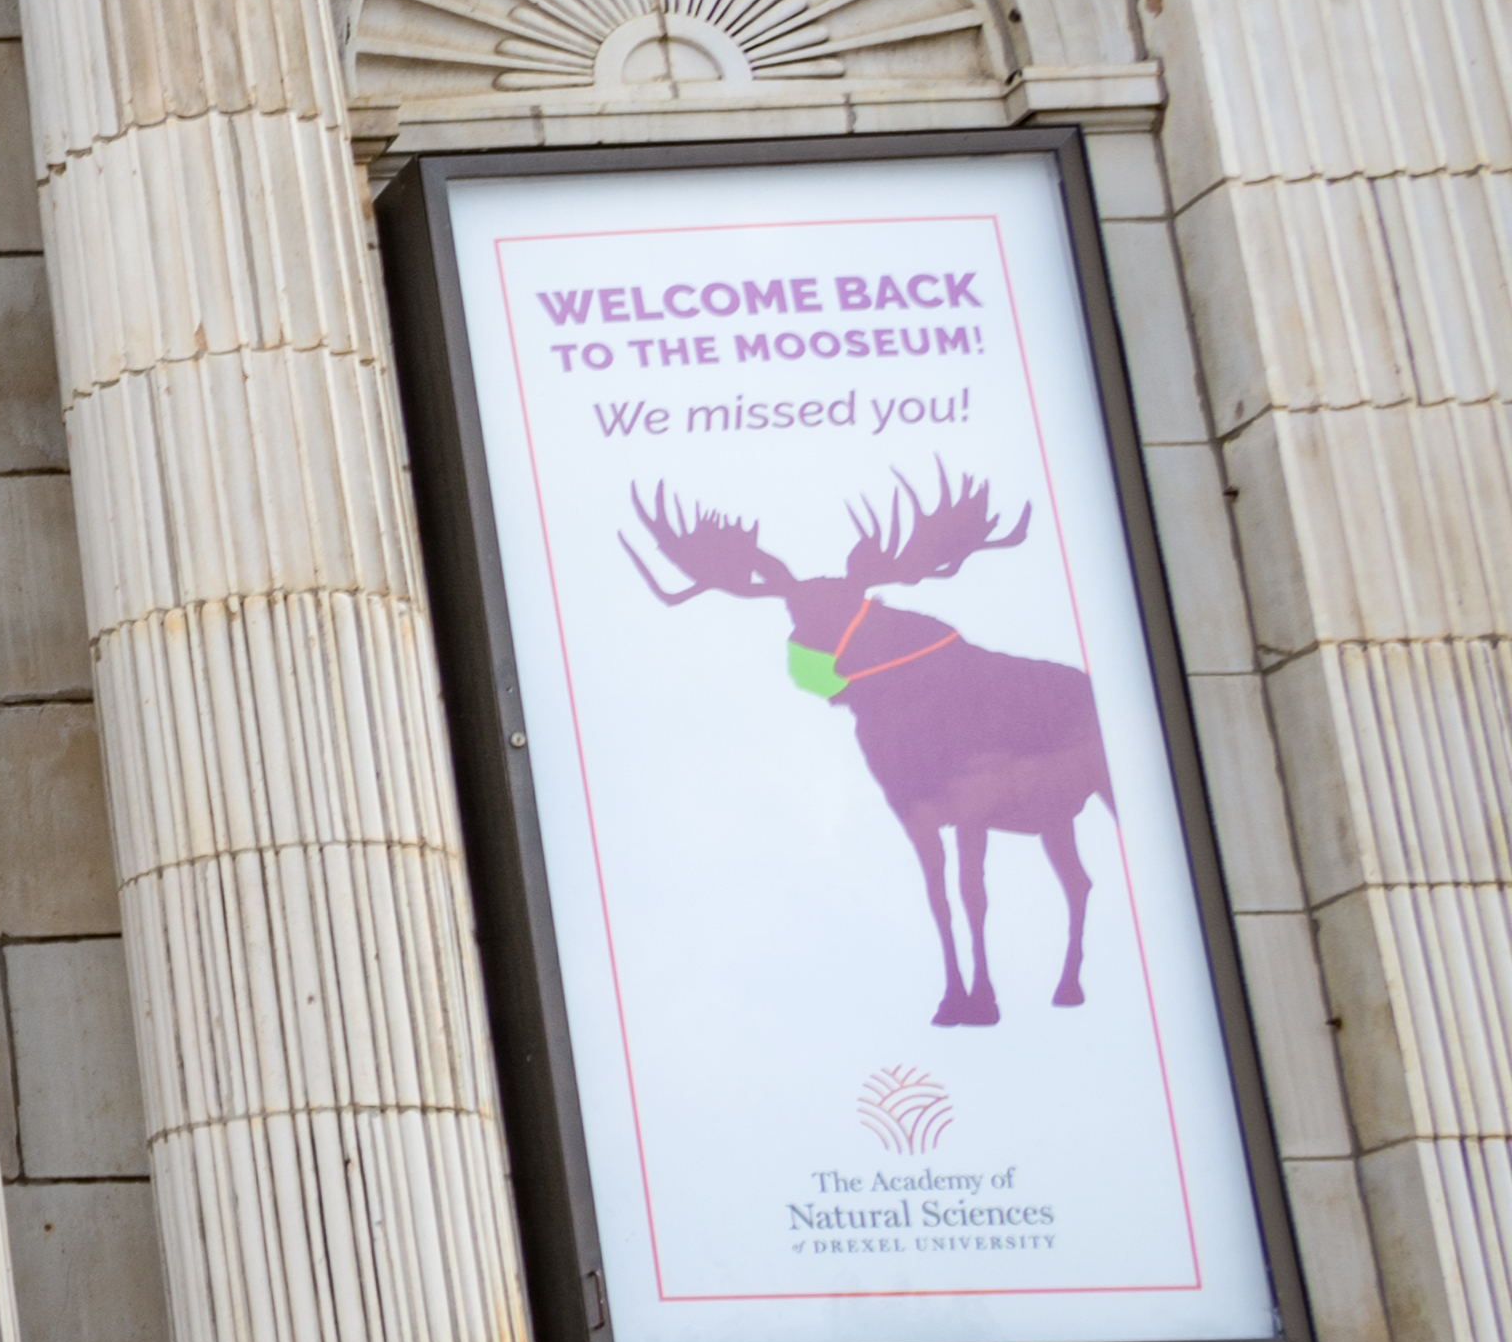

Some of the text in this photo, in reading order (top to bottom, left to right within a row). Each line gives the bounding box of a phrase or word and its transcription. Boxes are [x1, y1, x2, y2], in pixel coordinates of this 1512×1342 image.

[535, 272, 984, 326] WELCOME BACK
[550, 325, 985, 373] TO THE MOOSEUM!
[593, 387, 970, 438] We missed you!
[812, 1166, 1017, 1195] The Academy of
[786, 1198, 1056, 1230] Natural Sciences
[791, 1234, 1056, 1254] of DREXEL UNIVERSITY
